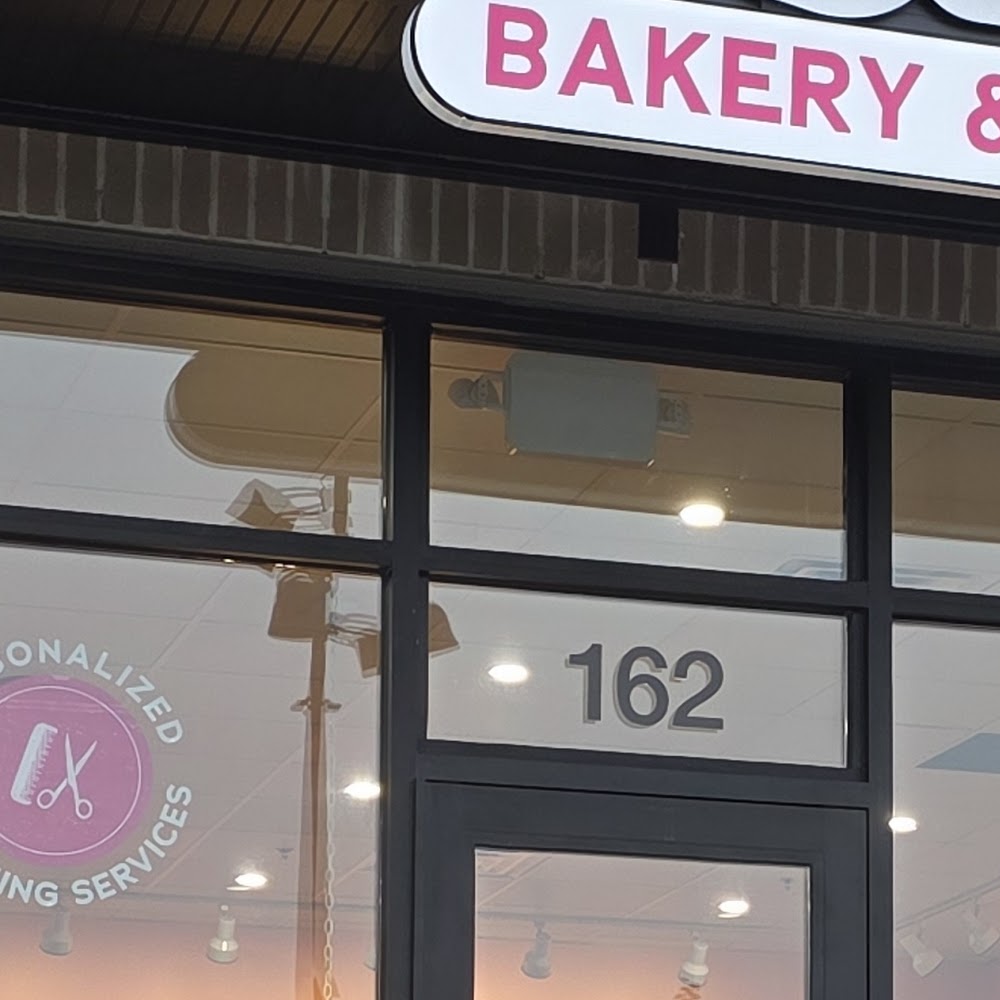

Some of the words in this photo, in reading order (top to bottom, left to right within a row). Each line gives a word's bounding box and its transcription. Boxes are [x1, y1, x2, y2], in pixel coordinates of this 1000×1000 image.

[485, 3, 924, 140] BAKERY
[0, 638, 184, 744] ONALIZED
[566, 642, 724, 731] 162
[71, 784, 192, 905] SERVICES
